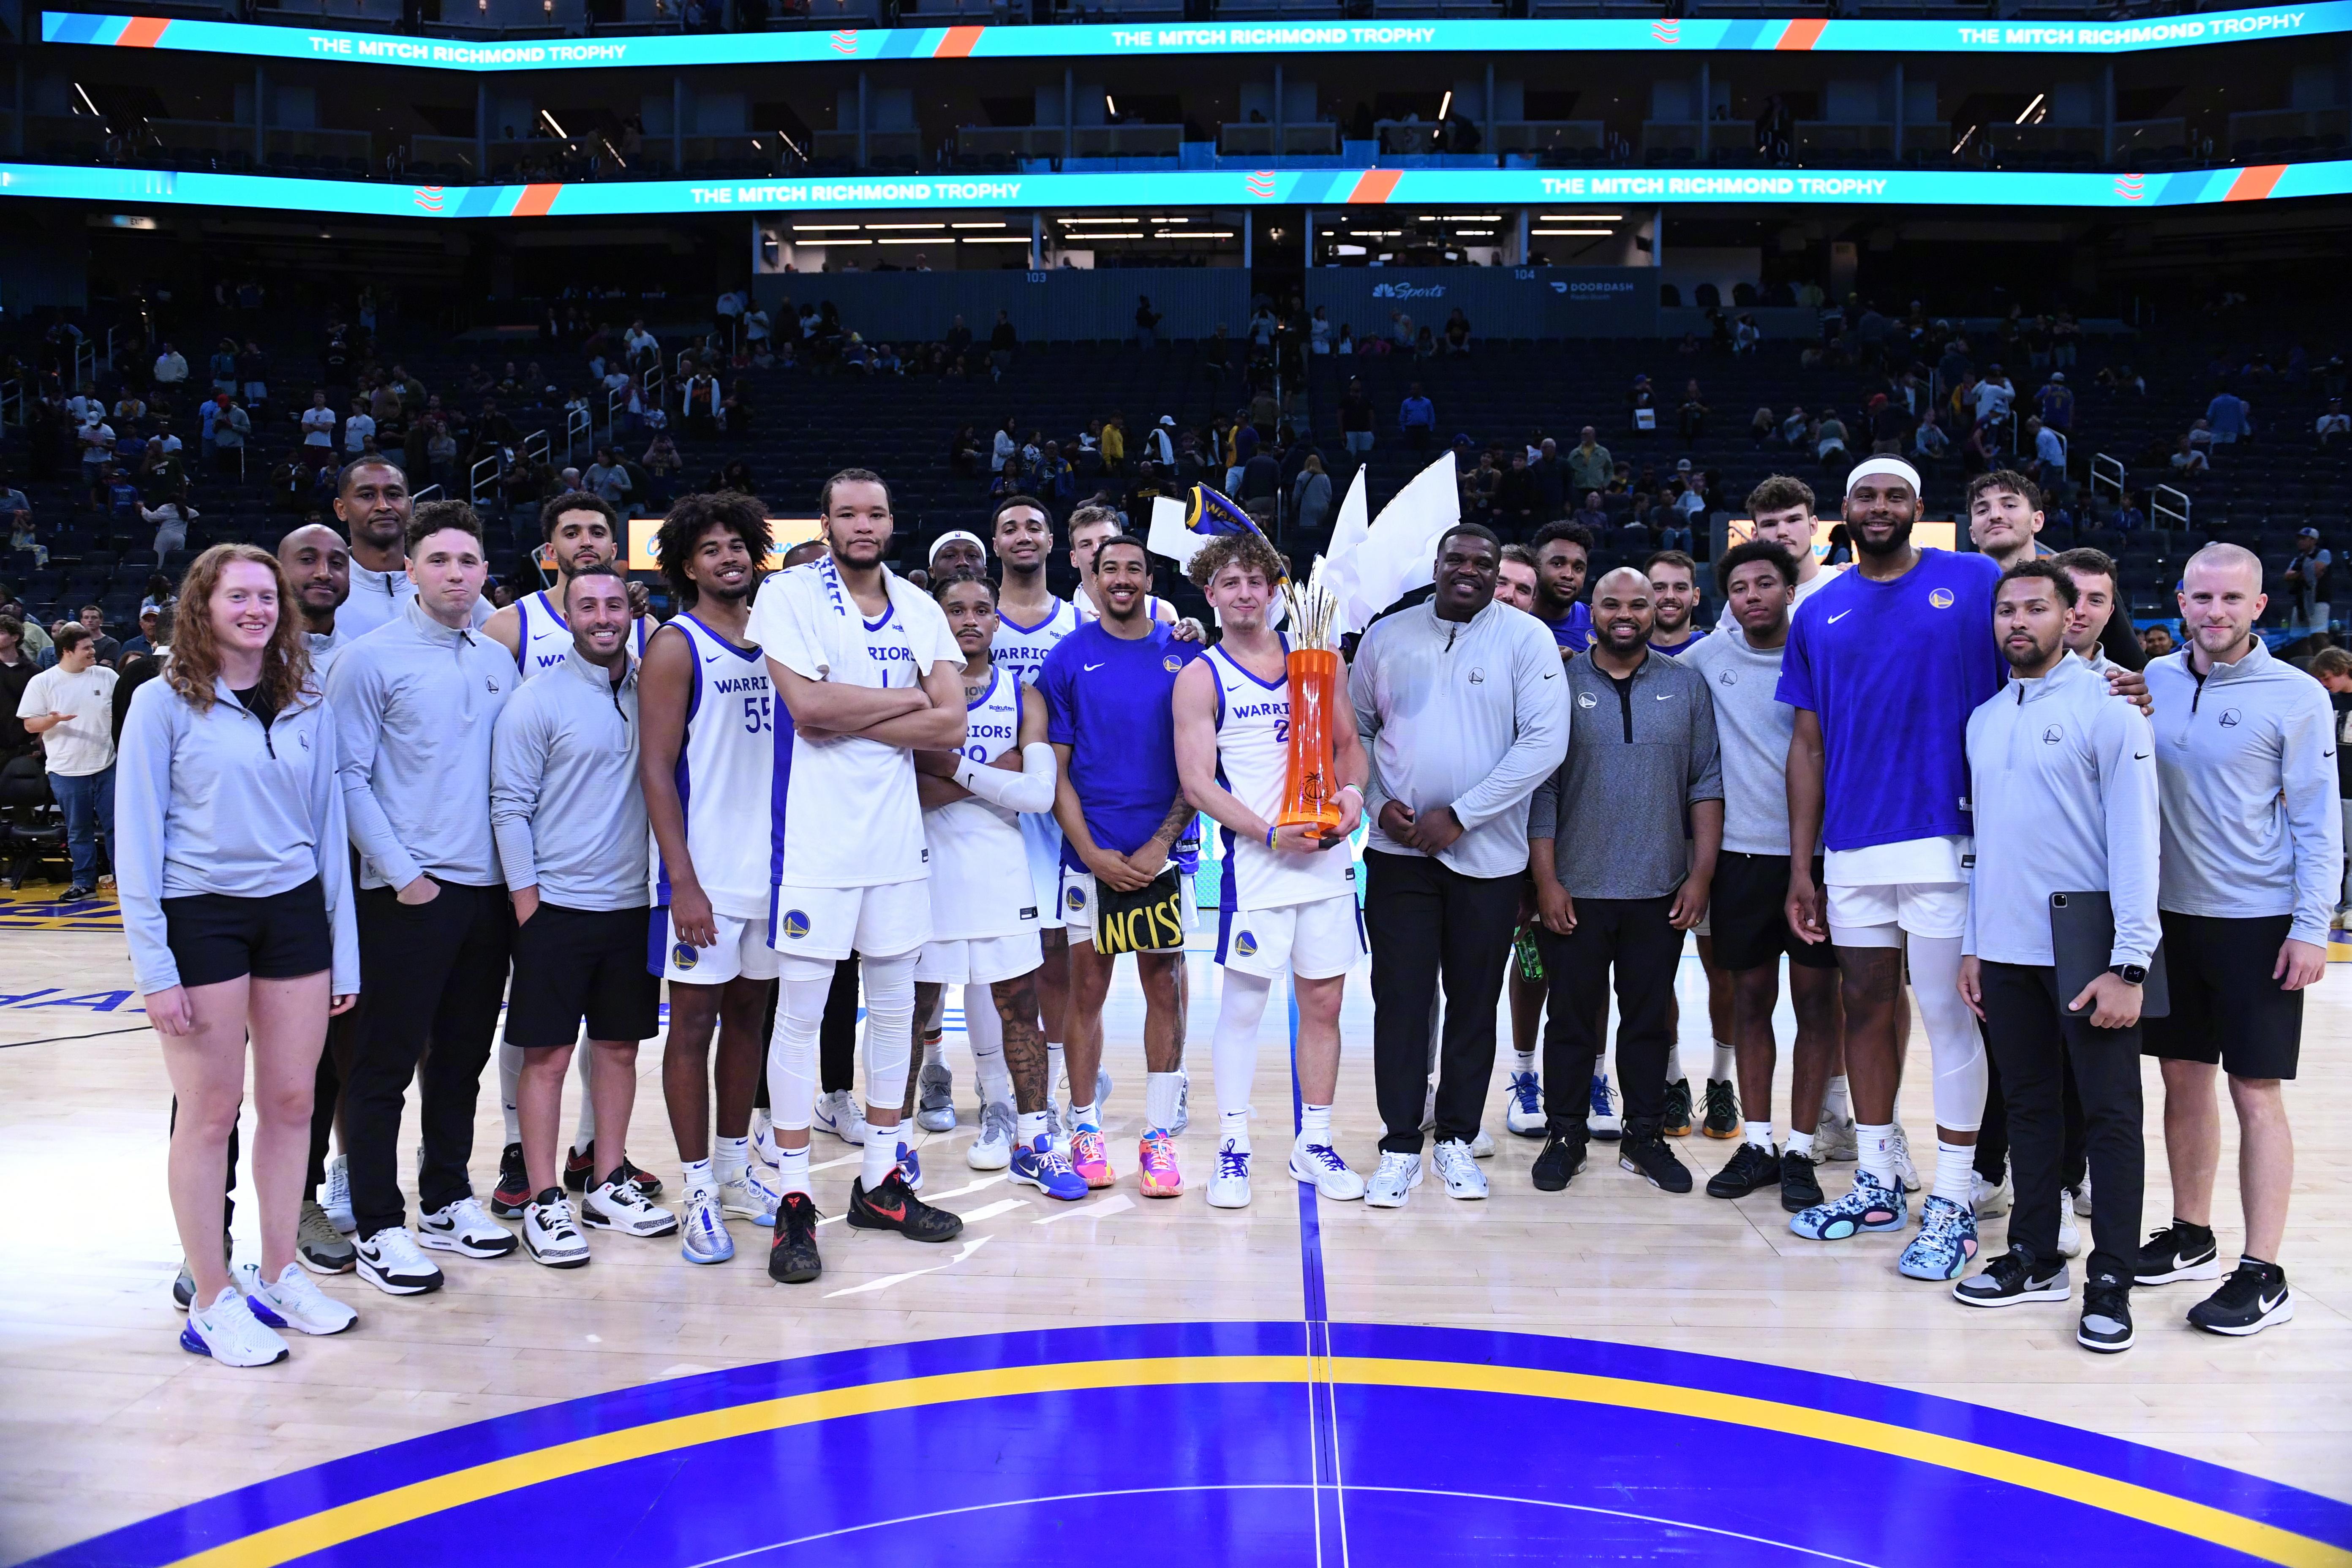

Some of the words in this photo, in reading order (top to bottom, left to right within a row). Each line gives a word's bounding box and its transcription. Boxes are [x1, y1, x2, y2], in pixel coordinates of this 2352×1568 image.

[1112, 31, 1152, 46] THE
[1158, 30, 1225, 46] MITCH
[1230, 29, 1347, 45] RICHMOND
[1351, 27, 1435, 44] TROPHY
[1958, 28, 2000, 44] THE
[2006, 29, 2073, 44] MITCH
[2078, 22, 2205, 45] RICHMOND
[2208, 13, 2305, 35] TROPHY
[309, 37, 351, 54] THE
[359, 41, 428, 59] MITCH
[434, 46, 544, 63] RICHMOND
[549, 45, 626, 61] TROPHY
[691, 188, 732, 204] THE
[738, 186, 806, 203] MITCH
[811, 184, 931, 201] RICHMOND
[934, 183, 1021, 199] TROPHY
[1541, 178, 1584, 194] THE
[1592, 177, 1663, 194] MITCH
[1669, 177, 1793, 194] RICHMOND
[1797, 178, 1886, 195] TROPHY
[1026, 272, 1046, 283] 103
[1515, 270, 1534, 280] 104
[1394, 282, 1446, 300] Sports
[1571, 283, 1633, 291] DOORDASH
[713, 676, 769, 694] WARRI
